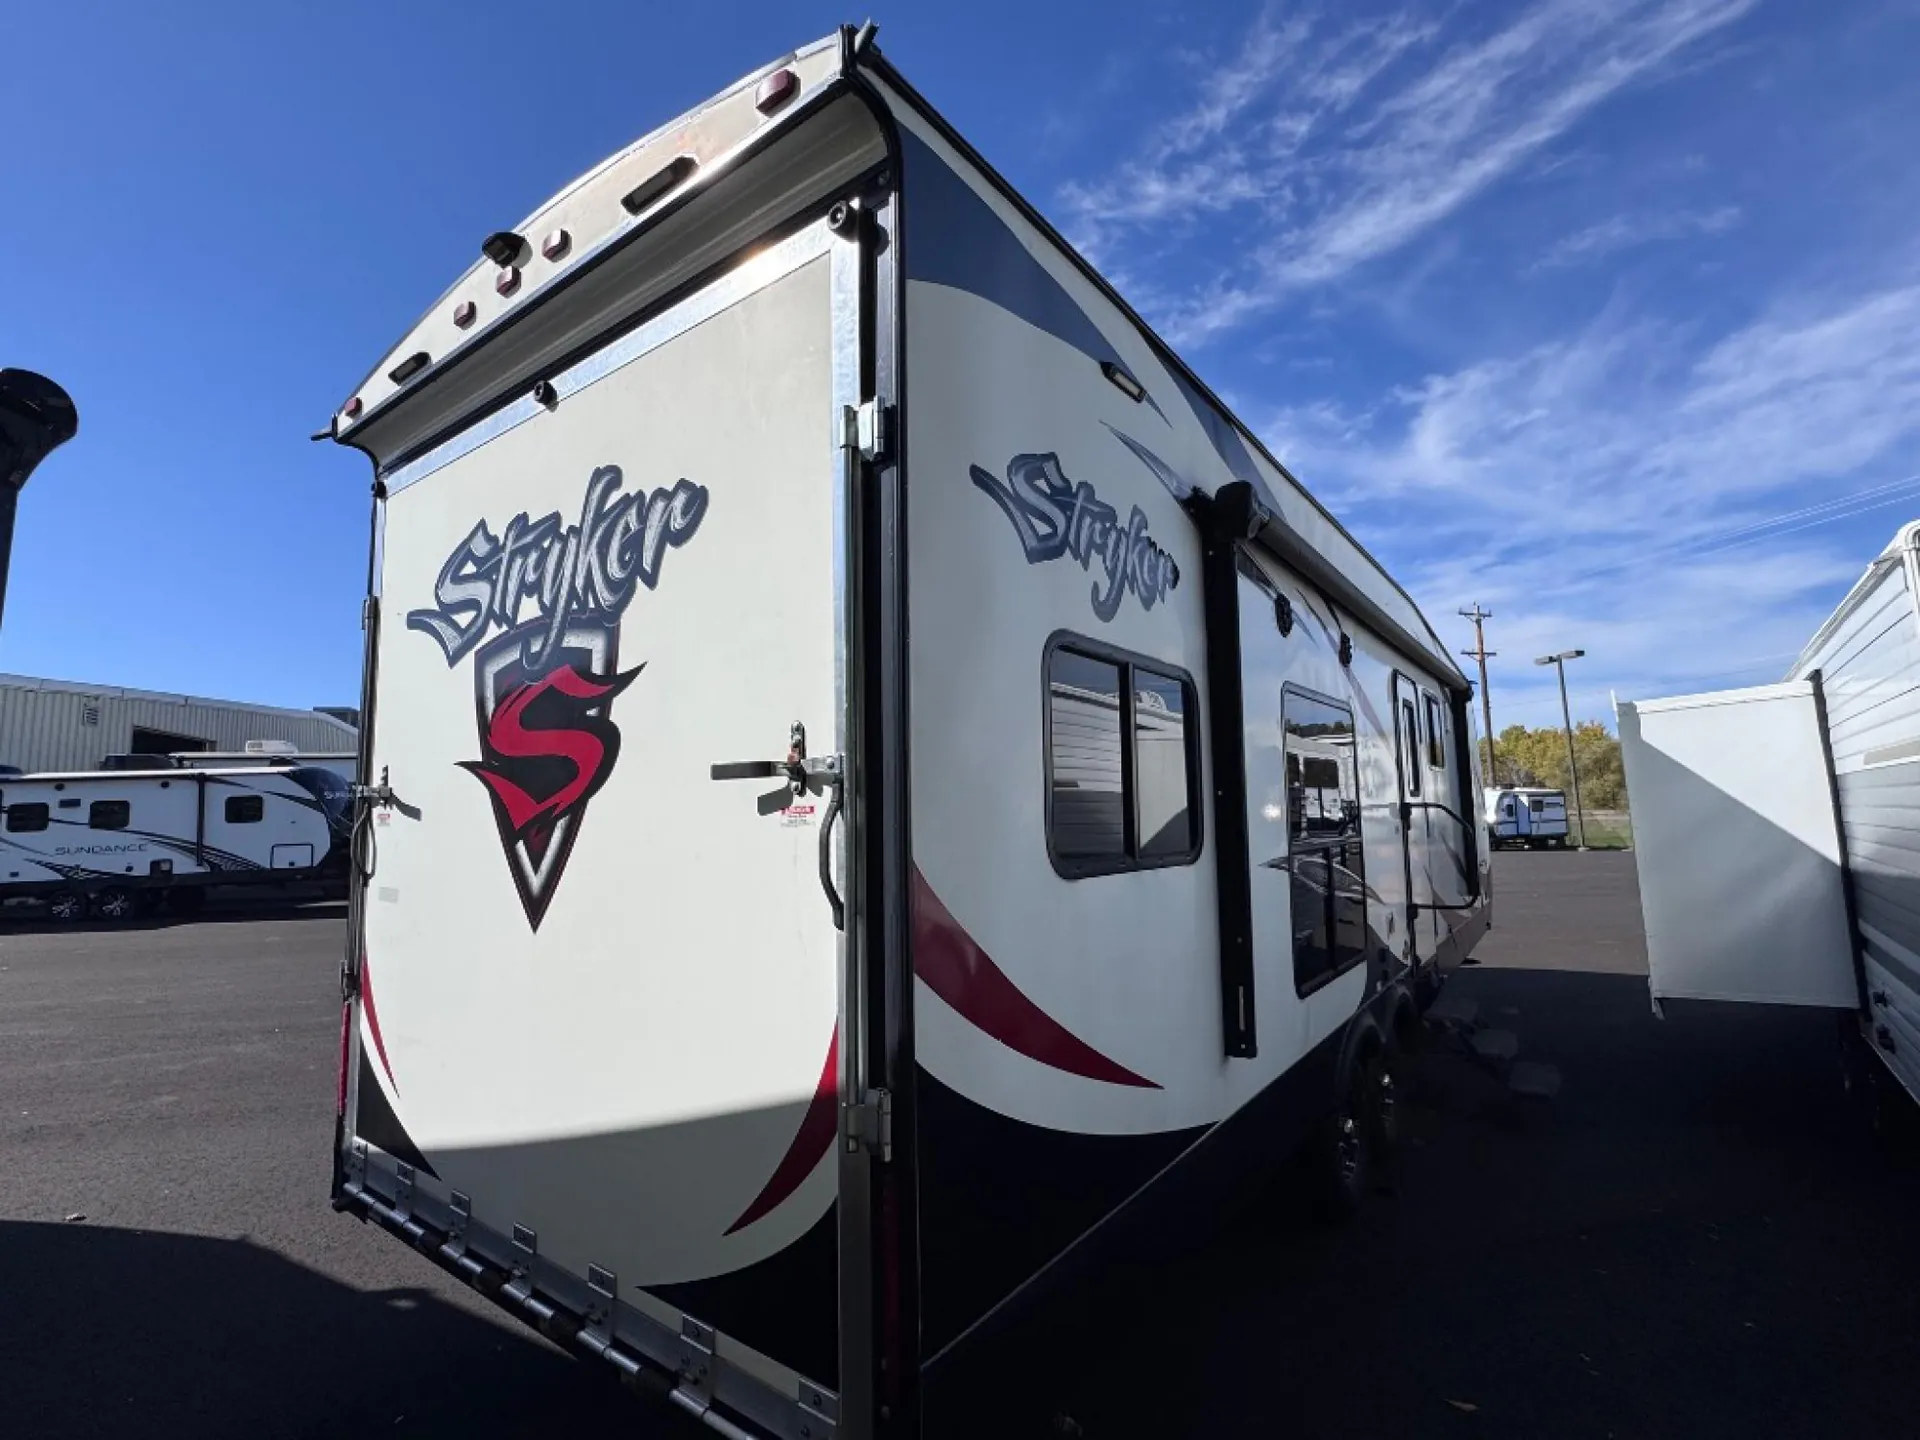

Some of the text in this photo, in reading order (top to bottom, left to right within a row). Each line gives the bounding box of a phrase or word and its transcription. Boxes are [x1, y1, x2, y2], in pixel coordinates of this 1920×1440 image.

[407, 465, 709, 675] Stryker
[969, 452, 1180, 622] Stryker
[456, 662, 645, 840] S
[54, 843, 149, 856] SUNDANCE
